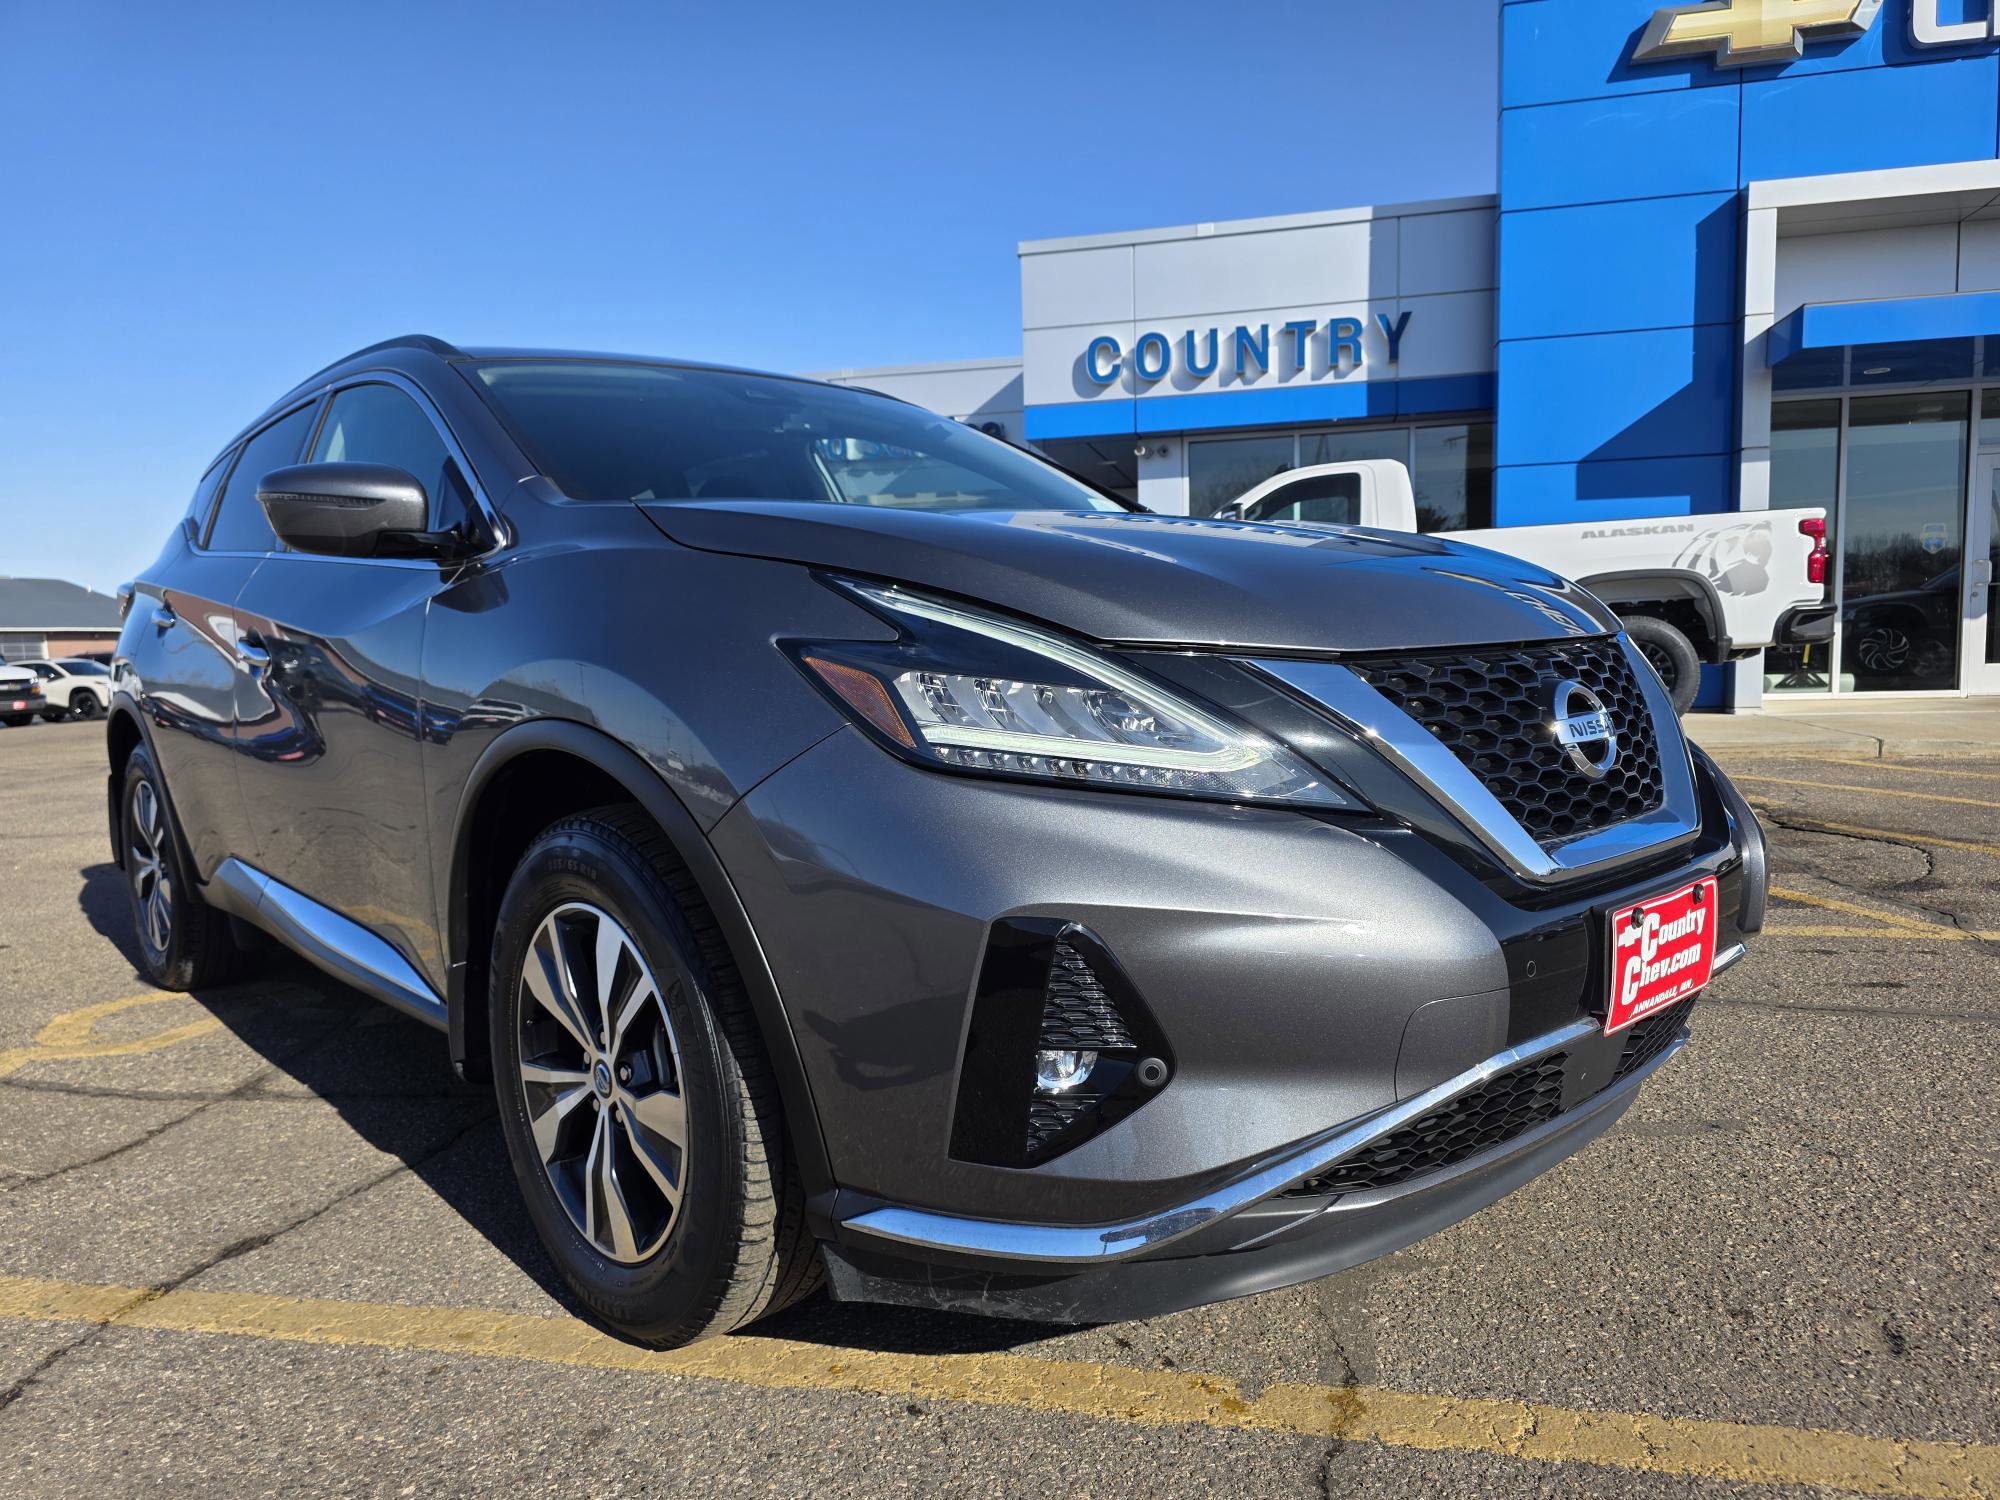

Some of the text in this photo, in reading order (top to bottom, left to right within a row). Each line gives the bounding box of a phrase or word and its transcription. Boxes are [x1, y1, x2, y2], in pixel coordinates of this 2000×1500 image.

[1086, 311, 1413, 386] COUNTRY
[1581, 523, 1694, 540] ALASKAN
[1641, 907, 1707, 962] Country
[1621, 943, 1702, 1006] Chev.com
